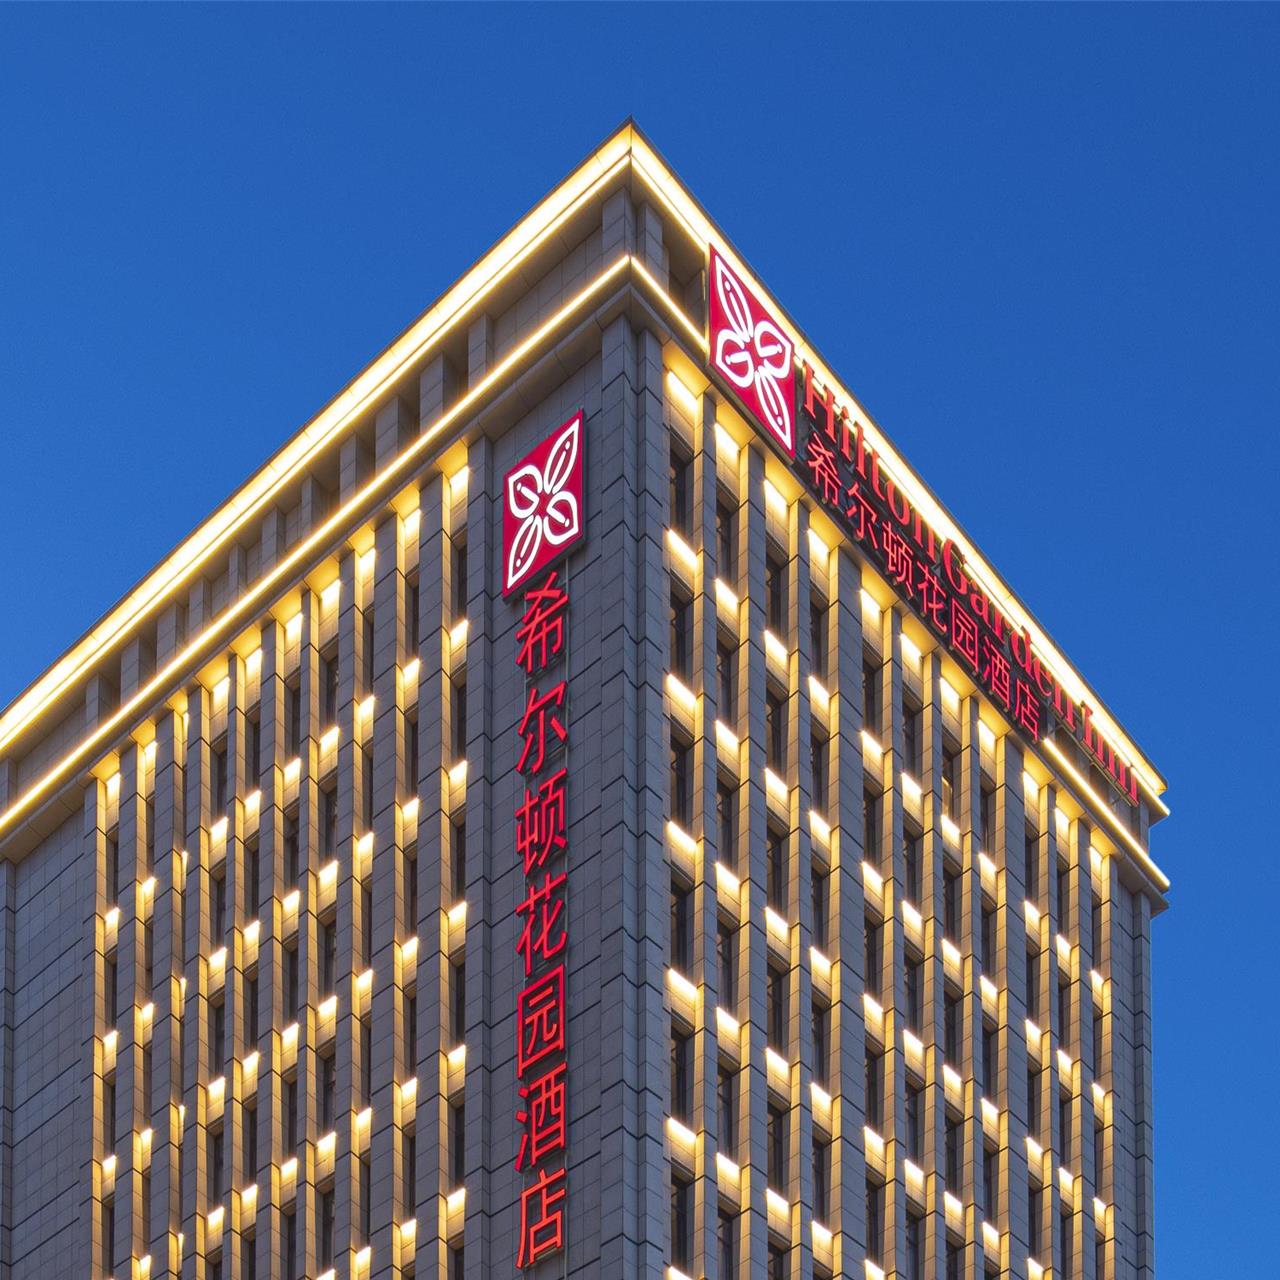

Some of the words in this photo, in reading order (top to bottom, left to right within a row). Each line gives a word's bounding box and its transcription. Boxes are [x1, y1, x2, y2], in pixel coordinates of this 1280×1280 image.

[808, 433, 1039, 741] 希尔顿花园酒店
[514, 571, 568, 1269] 希尔顿花园酒店
